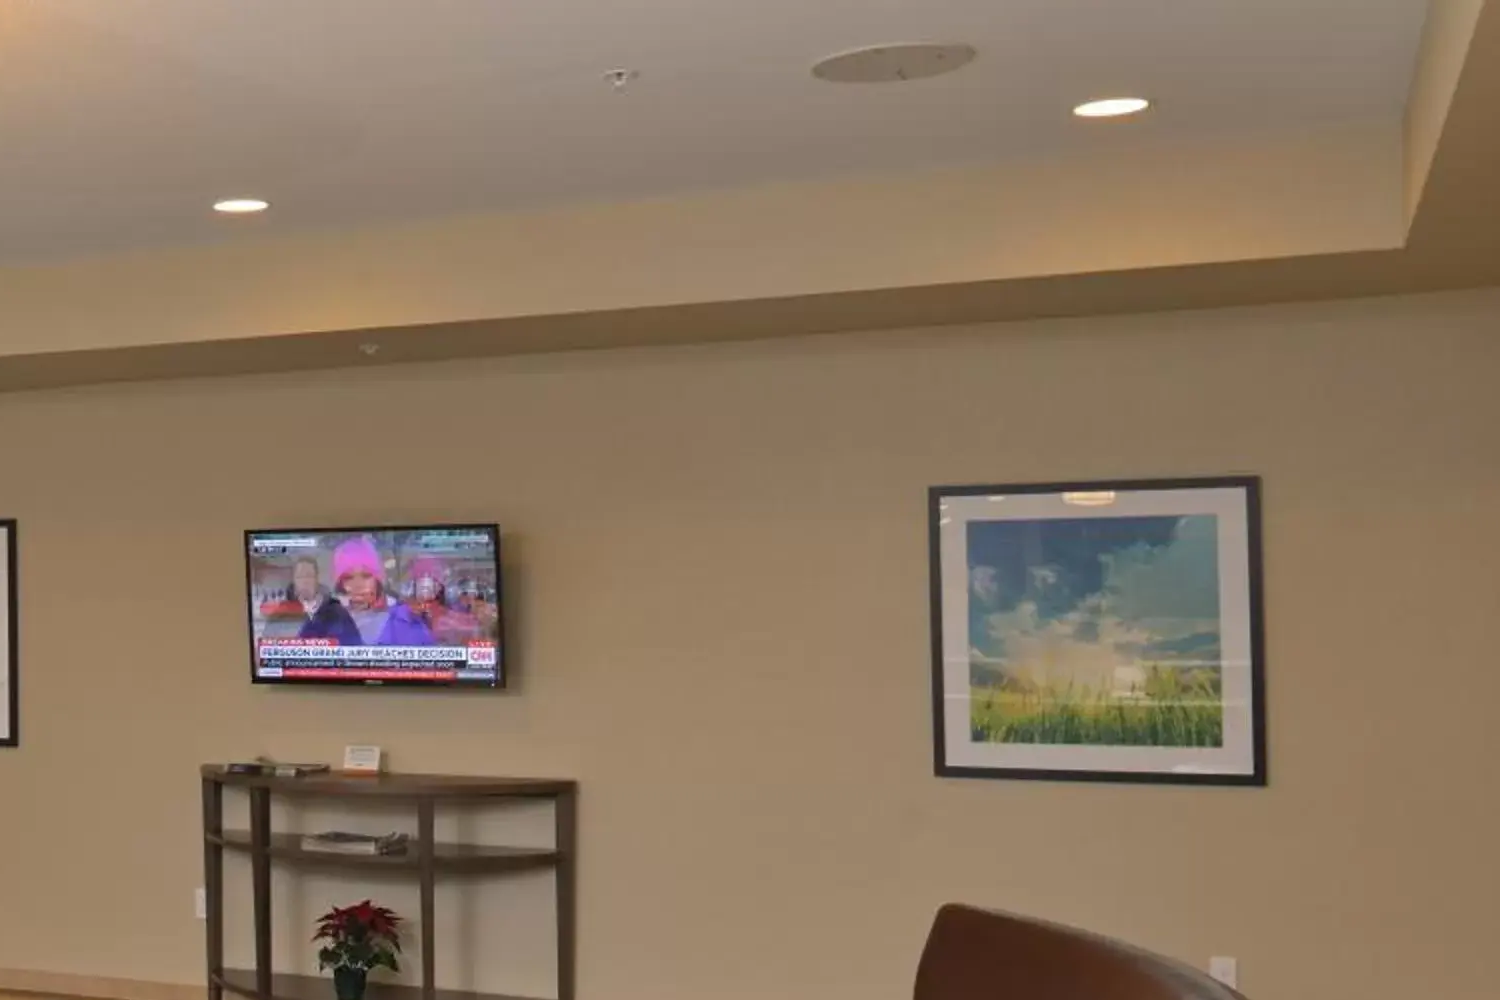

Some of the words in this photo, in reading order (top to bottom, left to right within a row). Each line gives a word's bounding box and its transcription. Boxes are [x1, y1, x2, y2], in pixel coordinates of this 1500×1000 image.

[262, 648, 310, 658] FERGUSON
[347, 649, 369, 658] JURY
[372, 649, 415, 659] REACHES
[418, 649, 463, 659] DECISION
[470, 650, 493, 662] CNN
